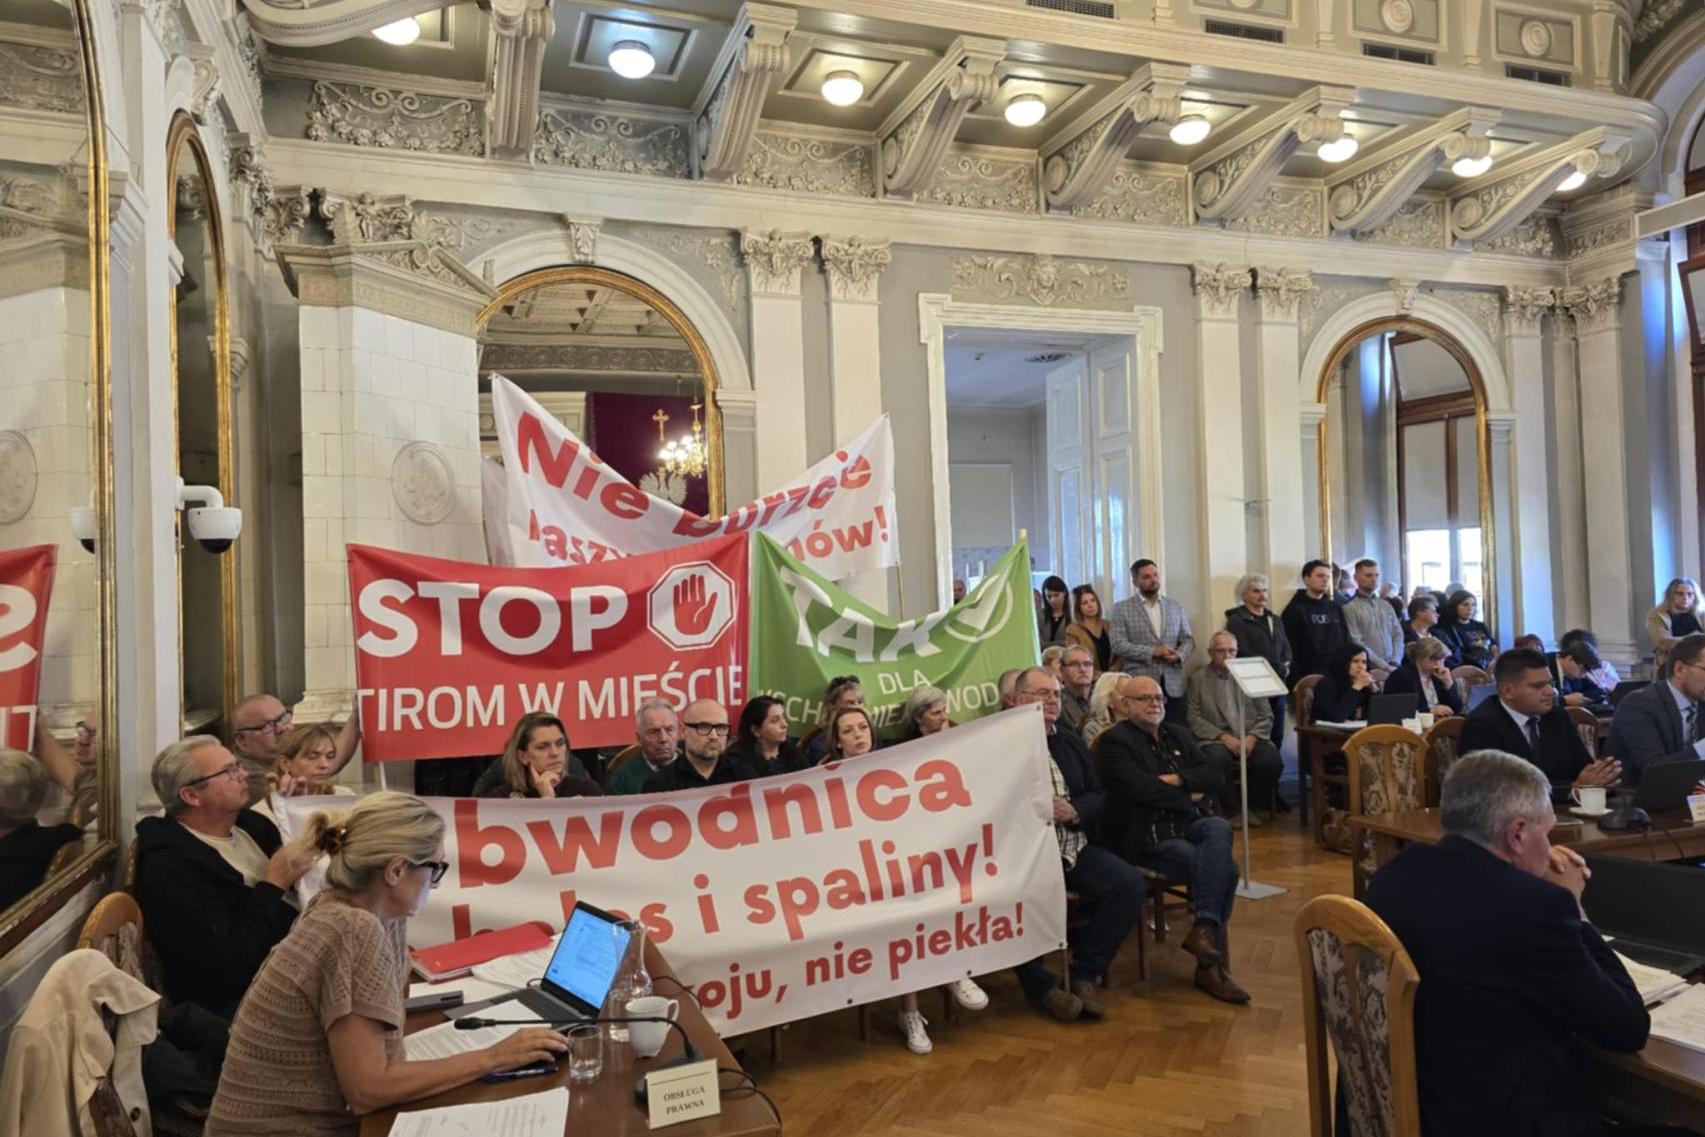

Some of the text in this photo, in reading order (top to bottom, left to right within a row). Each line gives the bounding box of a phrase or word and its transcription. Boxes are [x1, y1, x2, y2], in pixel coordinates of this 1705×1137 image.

[517, 410, 650, 520] Nie
[357, 578, 628, 658] STOP
[780, 566, 948, 663] TAK
[357, 660, 742, 732] TIROM W MIEŚCIE
[878, 669, 931, 695] DLA
[945, 681, 999, 714] WOD
[453, 758, 972, 889] bwodnica
[692, 873, 720, 934] i
[744, 823, 998, 942] spaliny!
[686, 902, 1024, 1020] oju, nie piekła!
[663, 1086, 706, 1101] OBSŁUGA
[666, 1099, 705, 1115] PRAWNA
